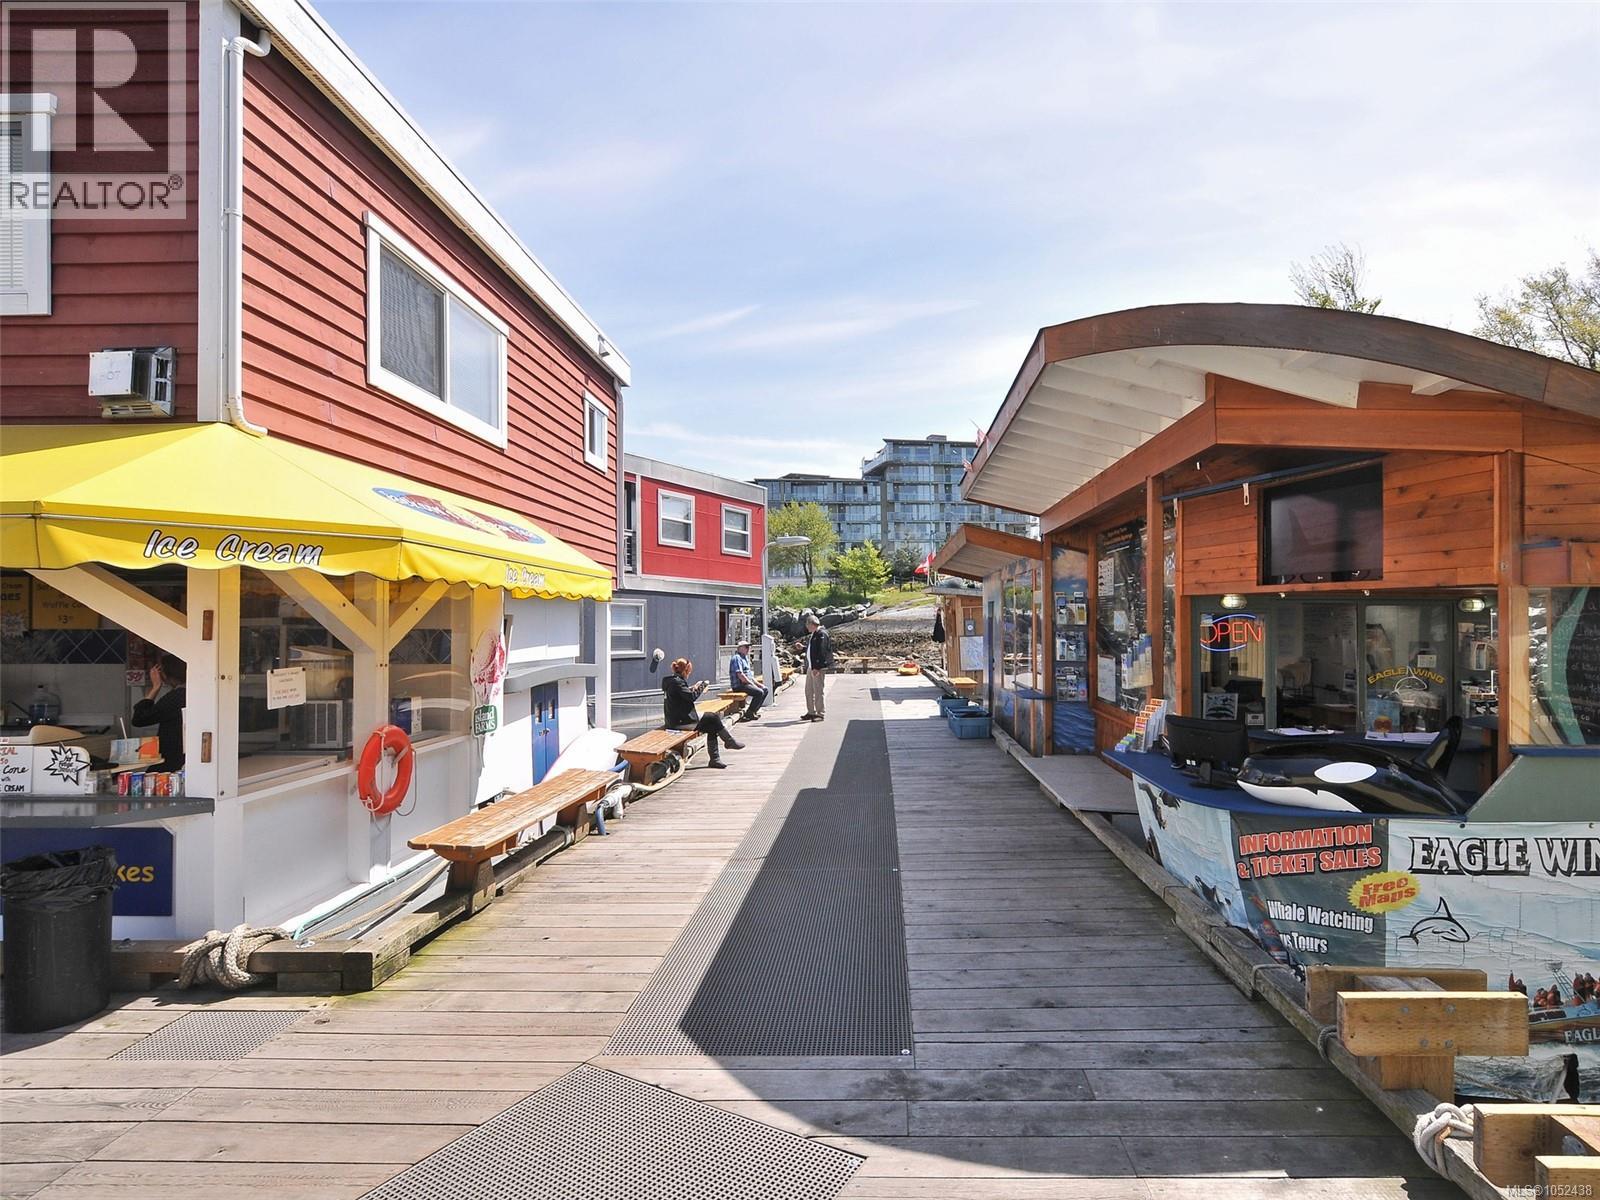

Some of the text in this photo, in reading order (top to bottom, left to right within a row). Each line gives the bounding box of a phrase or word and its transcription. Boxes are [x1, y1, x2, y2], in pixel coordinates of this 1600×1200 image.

[144, 529, 324, 567] Ice Cream
[505, 563, 545, 587] Ice Cream
[1200, 621, 1262, 643] OPEN
[1367, 666, 1446, 685] EAGLE WING
[2, 765, 30, 775] Cone
[4, 784, 25, 793] CREAM
[1238, 824, 1373, 856] INFORMATION
[1236, 847, 1382, 879] & TICKET SALES
[1408, 836, 1531, 876] EAGLE
[1358, 886, 1417, 908] Maps
[1362, 876, 1409, 896] Free
[1267, 900, 1374, 934] Whale Watching
[1293, 931, 1328, 954] Tours
